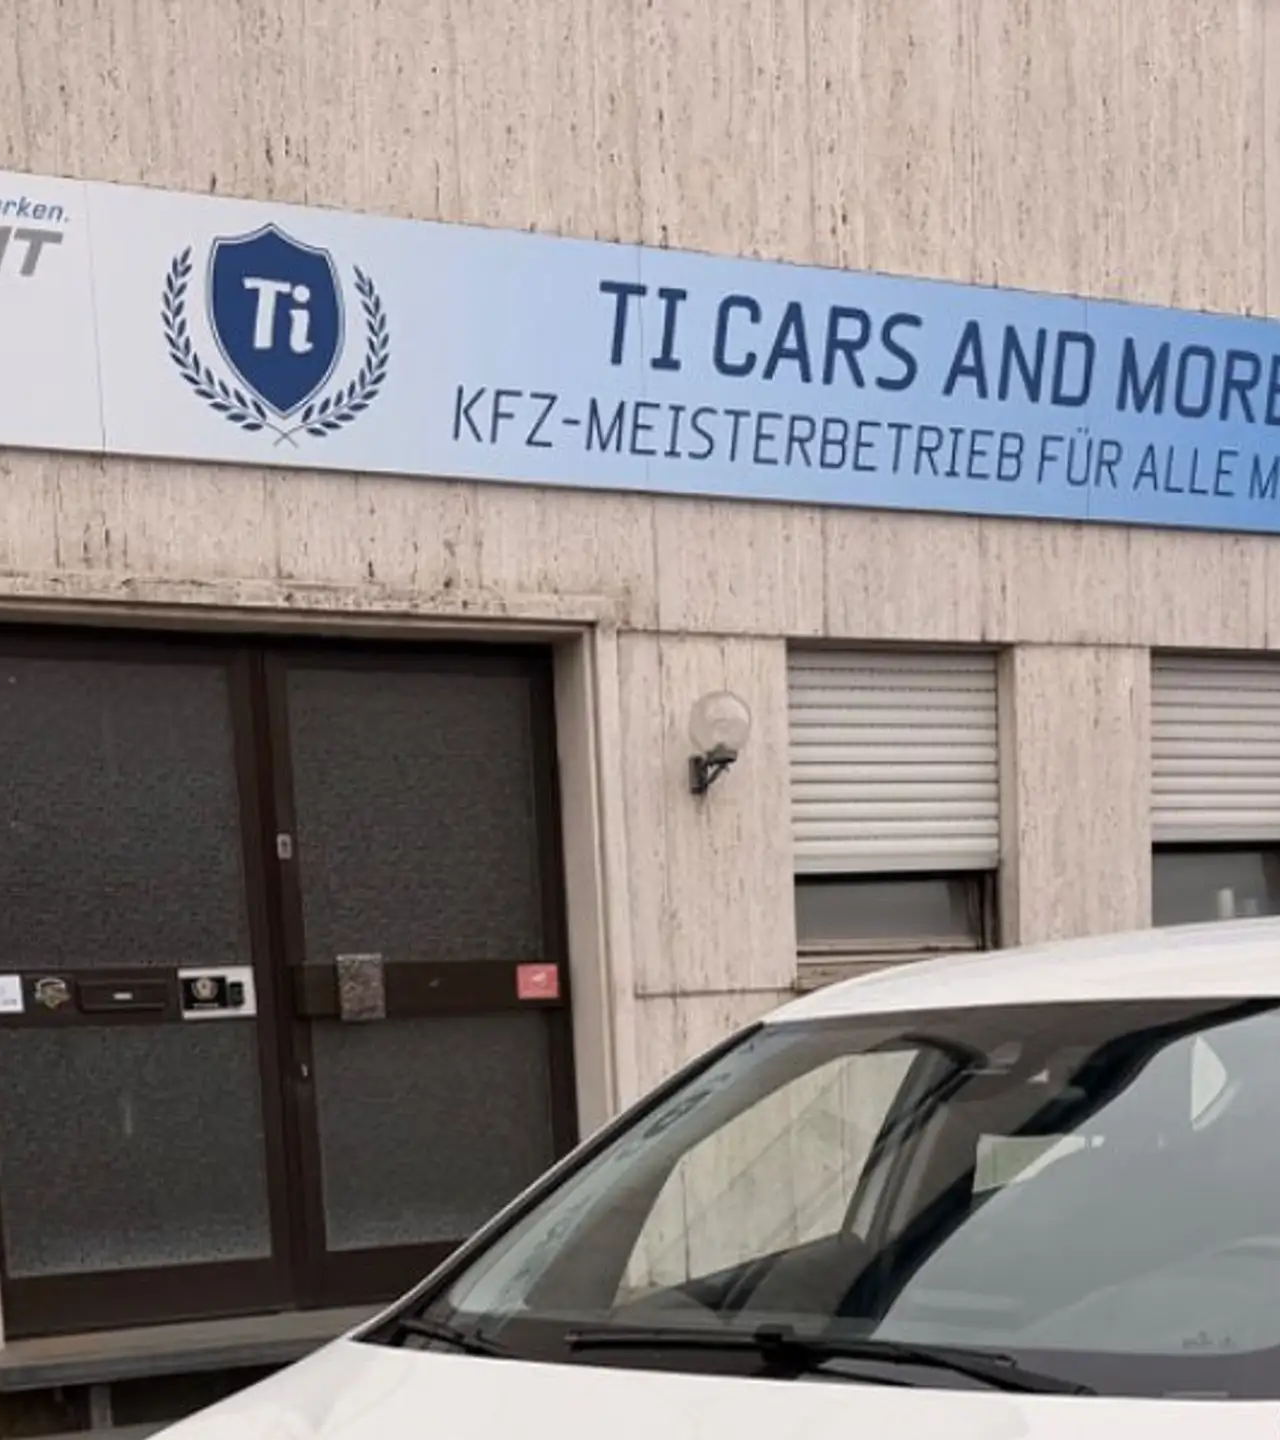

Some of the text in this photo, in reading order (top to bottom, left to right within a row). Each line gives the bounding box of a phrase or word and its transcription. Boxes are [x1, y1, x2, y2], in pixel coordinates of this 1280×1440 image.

[243, 276, 314, 354] Ti
[599, 280, 687, 371] TI
[713, 294, 923, 391] CARS
[942, 319, 1096, 407] AND
[452, 384, 1024, 484] KFZ-MEISTERBETRIEB
[1036, 425, 1122, 490] FÜR
[1132, 443, 1240, 498] ALLE
